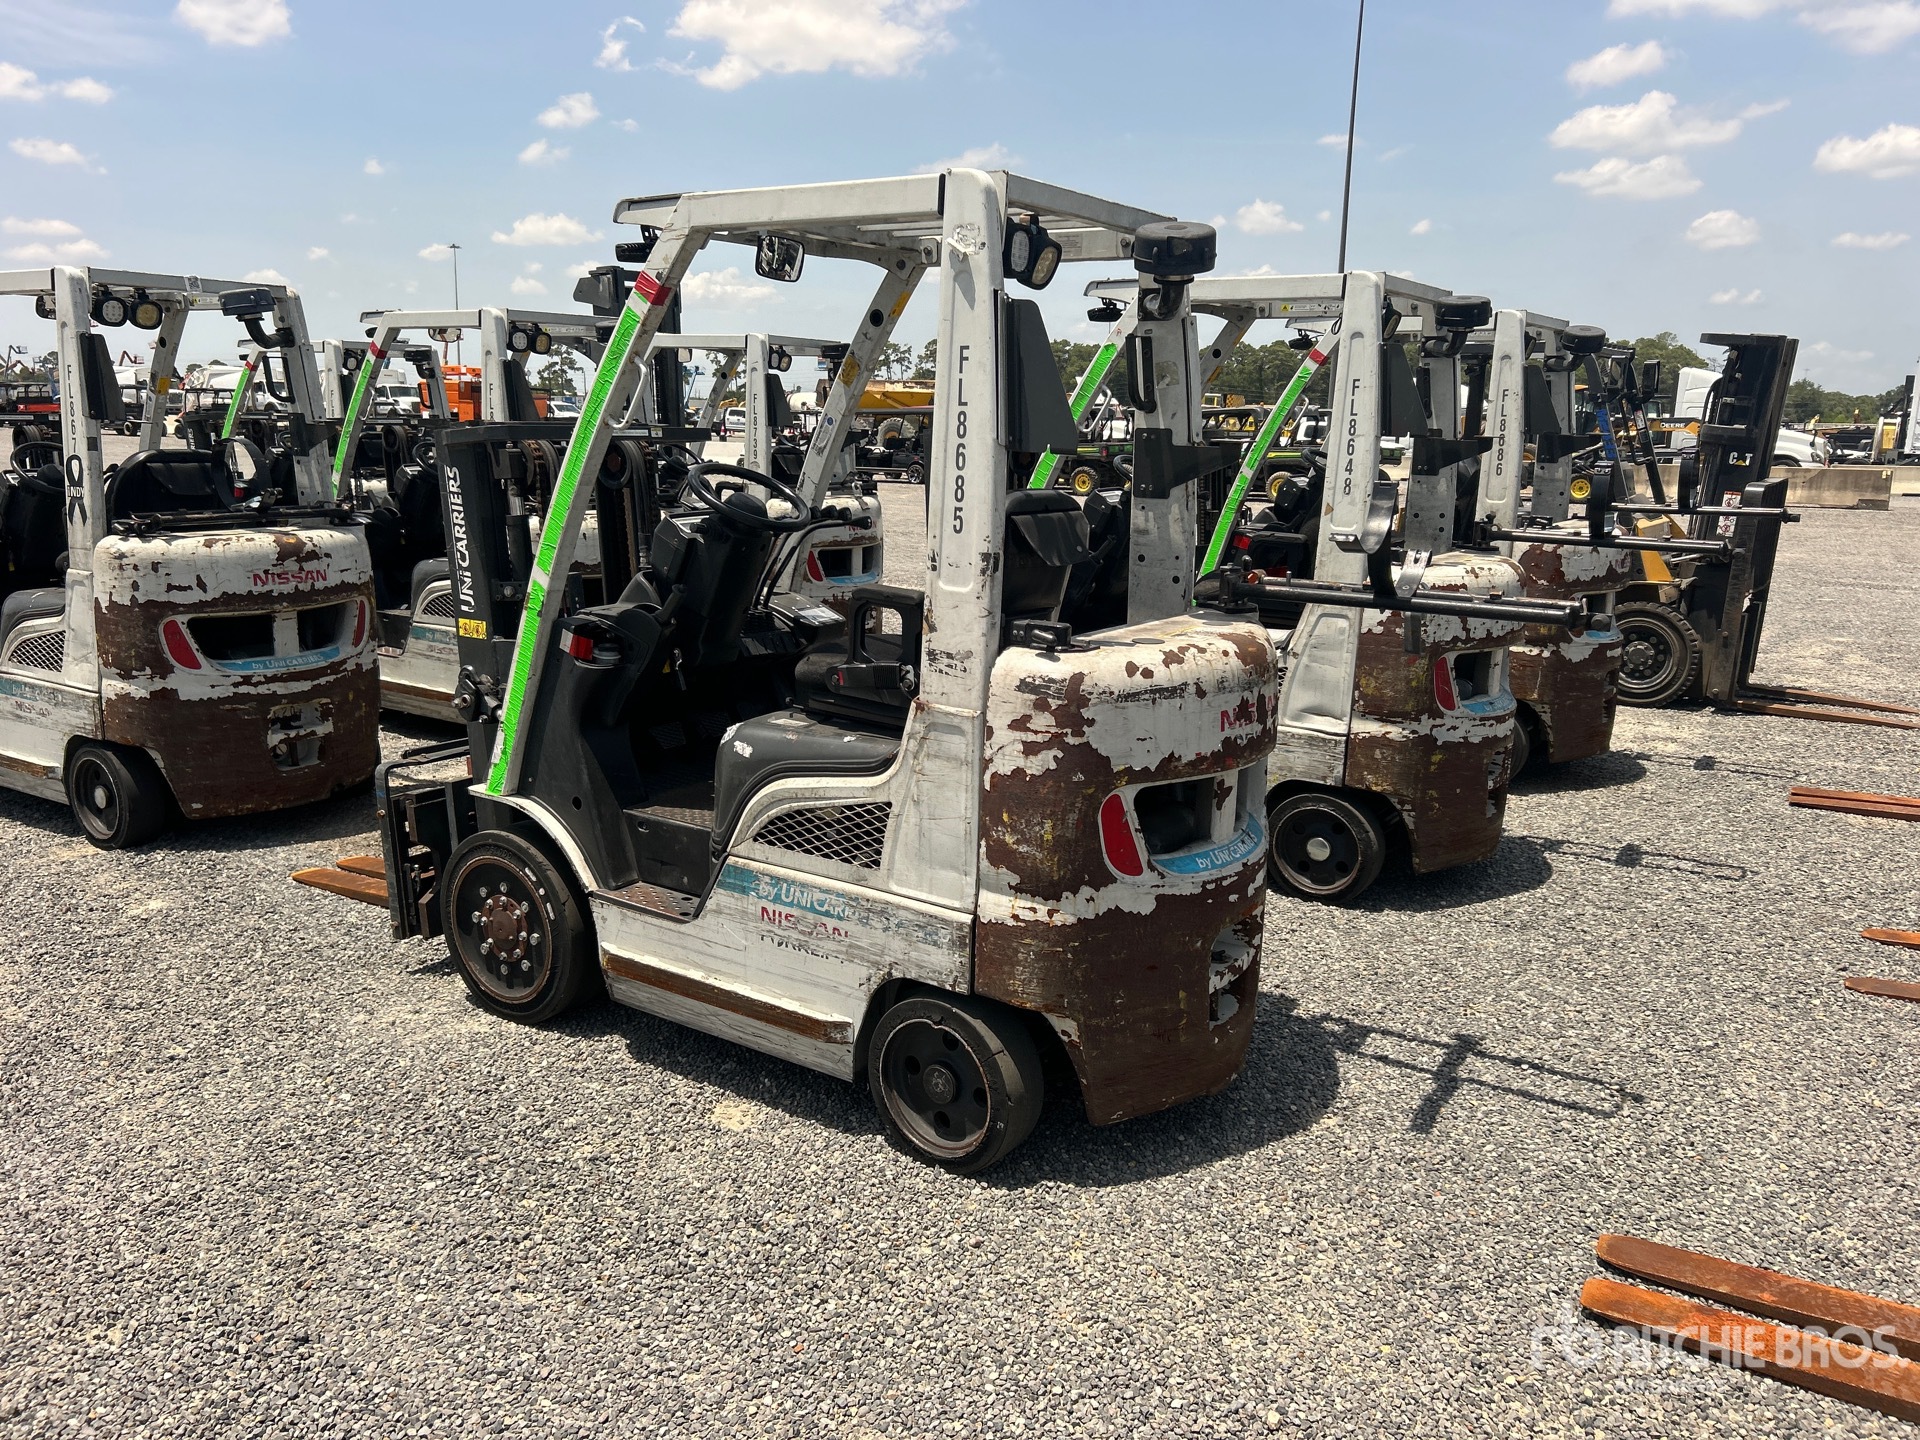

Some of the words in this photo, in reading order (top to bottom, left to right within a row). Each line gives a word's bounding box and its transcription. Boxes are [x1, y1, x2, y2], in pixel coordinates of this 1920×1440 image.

[952, 344, 970, 535] FL8685
[1343, 378, 1361, 496] FL8648
[1495, 388, 1510, 476] FL8686
[67, 484, 85, 498] INDY
[252, 569, 328, 587] NISSAN
[252, 661, 265, 670] by
[1195, 857, 1212, 869] by
